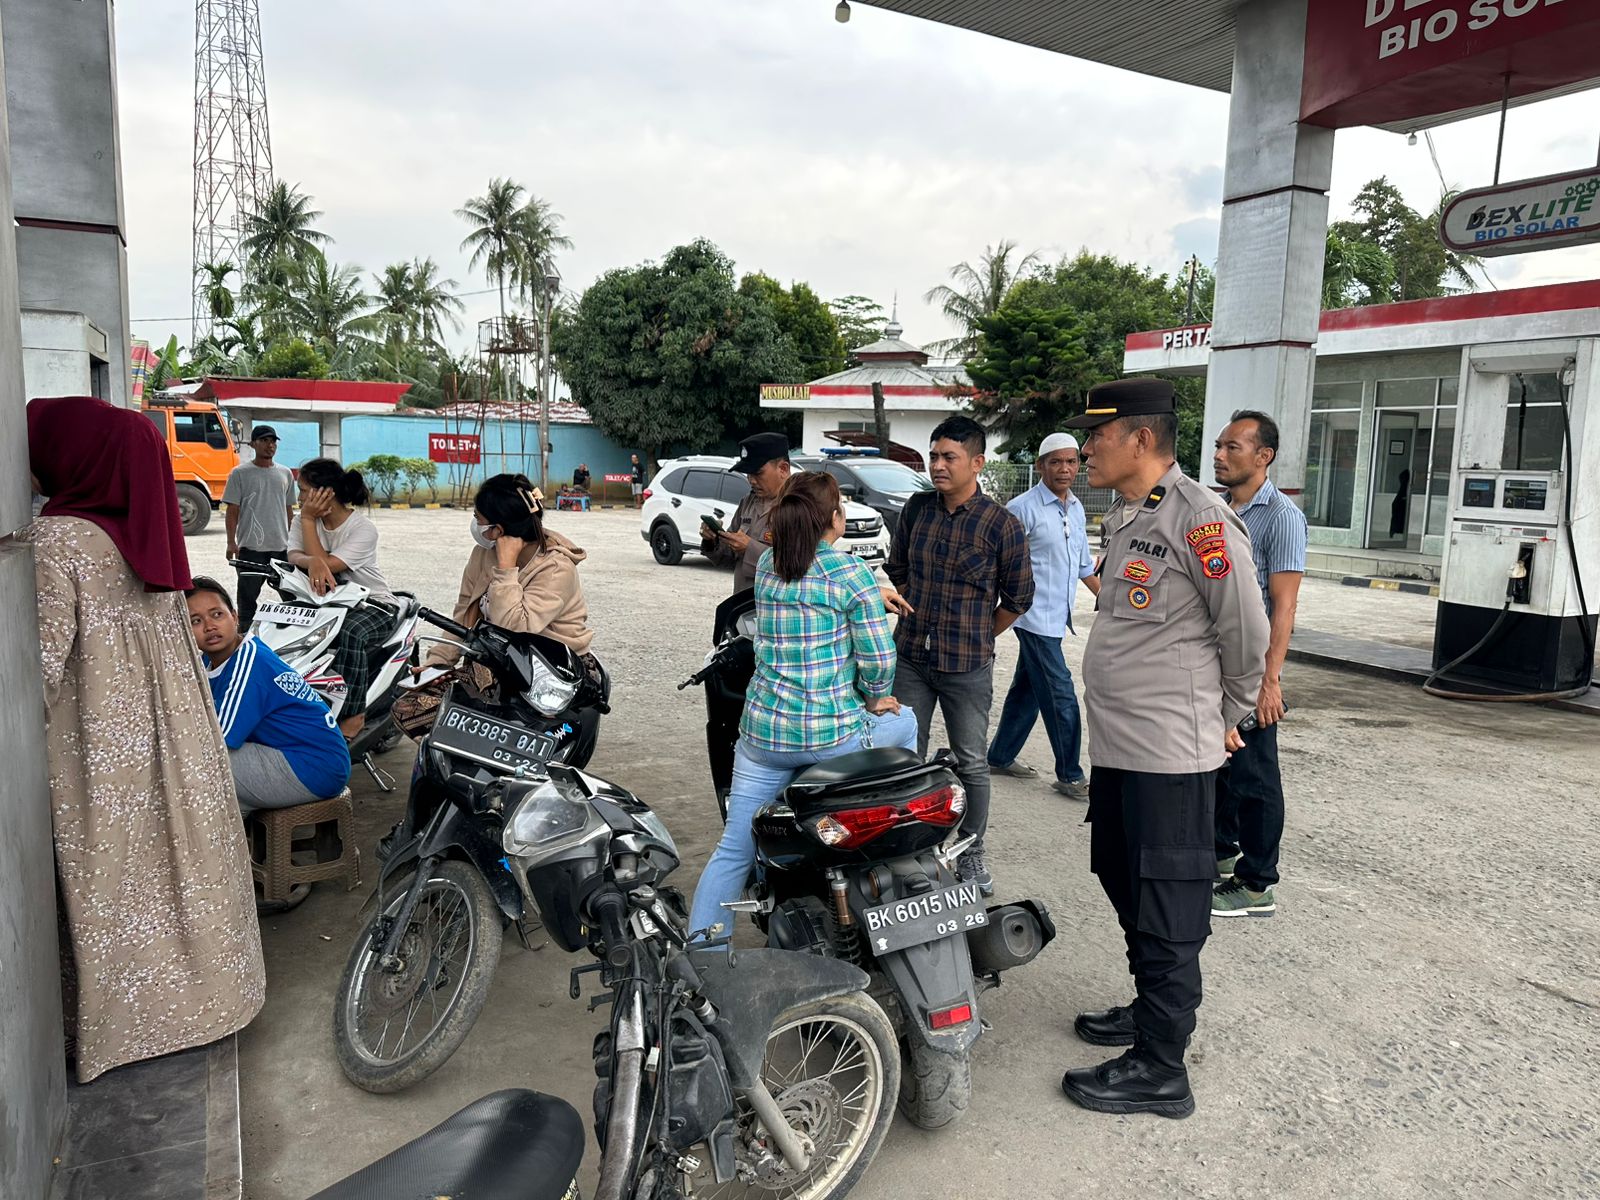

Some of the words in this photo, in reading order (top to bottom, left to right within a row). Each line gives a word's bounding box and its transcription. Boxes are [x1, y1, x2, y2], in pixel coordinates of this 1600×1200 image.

[1379, 8, 1458, 59] BIO
[1474, 228, 1508, 241] BIO
[1514, 216, 1580, 236] SOLAR
[761, 386, 810, 400] MUSHOLLAH
[1189, 524, 1221, 539] POLRES
[1129, 539, 1168, 558] POLRI
[259, 603, 274, 613] BK
[273, 605, 298, 615] 6655
[866, 907, 894, 931] BK
[895, 894, 942, 922] 6015
[944, 884, 977, 910] NAV
[936, 919, 958, 935] 03
[964, 912, 985, 927] 26
